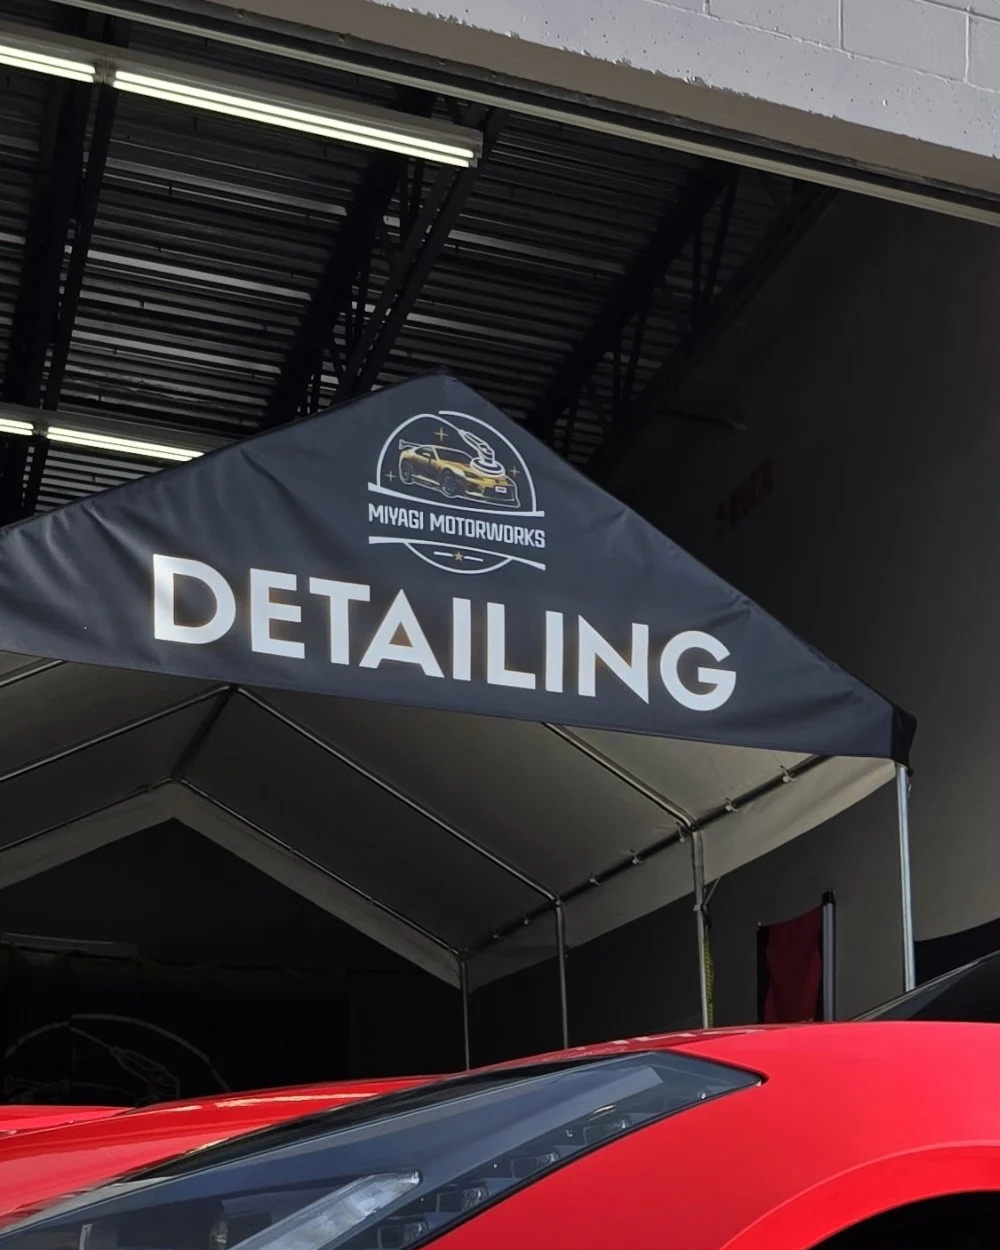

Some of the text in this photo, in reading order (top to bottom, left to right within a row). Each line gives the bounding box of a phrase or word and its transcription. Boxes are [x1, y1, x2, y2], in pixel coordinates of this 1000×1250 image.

[368, 503, 547, 549] MIYAGI MOTORWORKS
[153, 553, 737, 711] DETAILING
